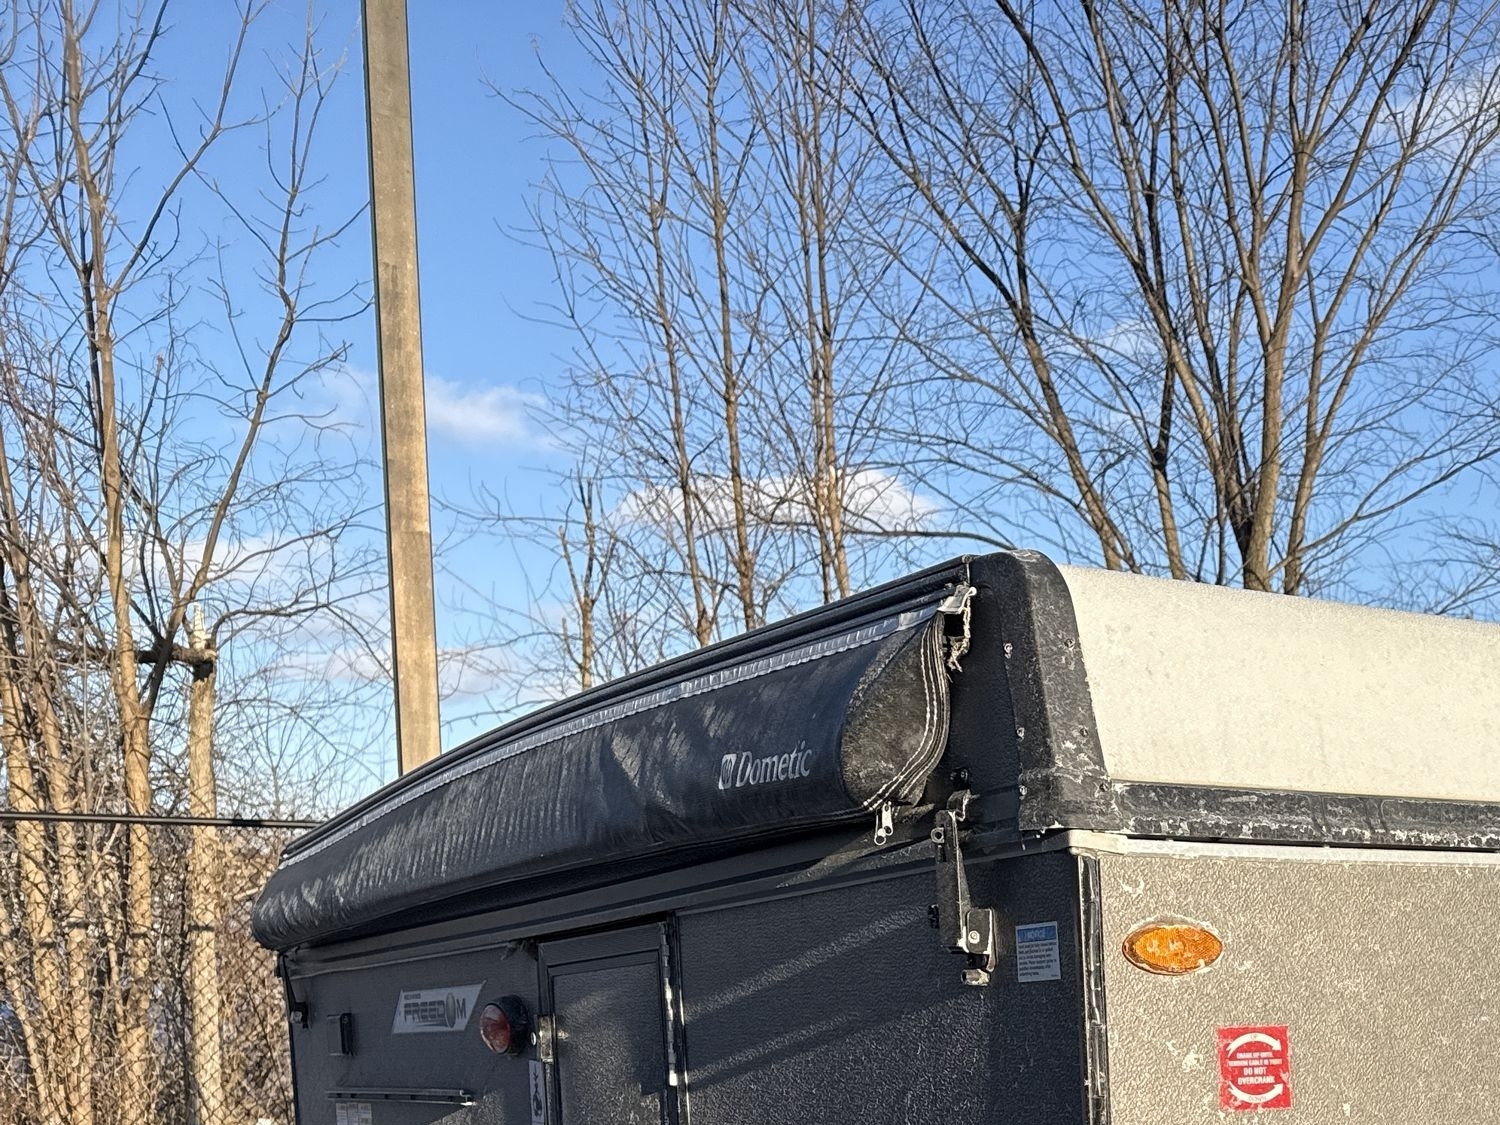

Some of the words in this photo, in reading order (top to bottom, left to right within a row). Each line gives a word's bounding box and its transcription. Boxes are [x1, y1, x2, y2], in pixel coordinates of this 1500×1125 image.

[735, 740, 812, 787] Dometic
[404, 995, 467, 1025] FREEDOM
[1237, 1075, 1276, 1085] OVERCRANK
[1243, 1067, 1253, 1075] DO
[1253, 1066, 1267, 1075] NOT
